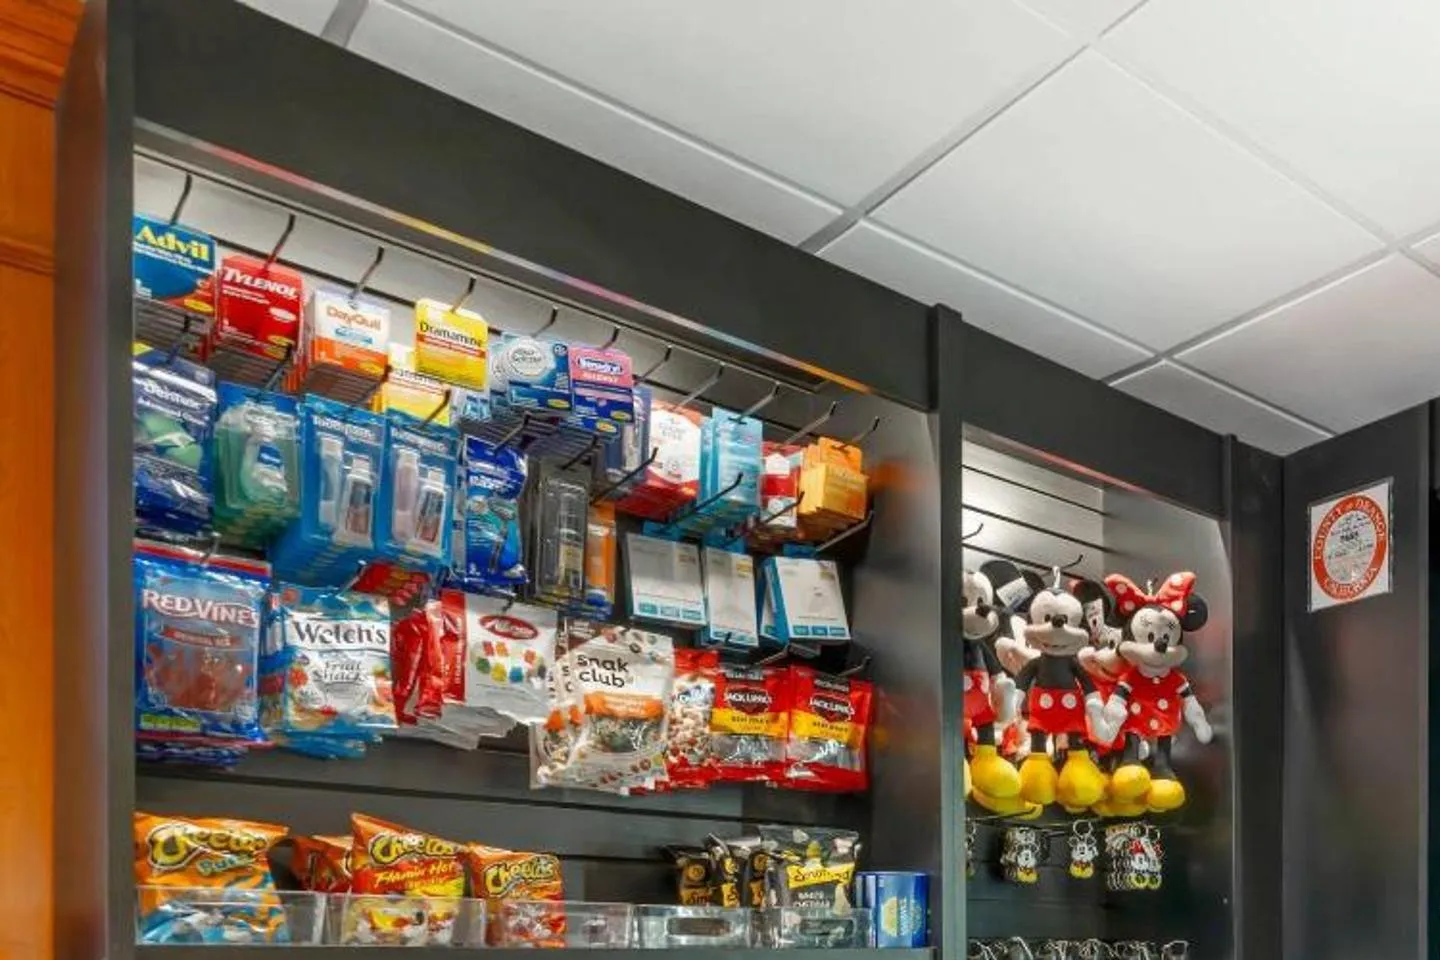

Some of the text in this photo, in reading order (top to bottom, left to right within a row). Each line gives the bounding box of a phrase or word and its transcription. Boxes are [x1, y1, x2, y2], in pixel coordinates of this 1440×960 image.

[136, 224, 209, 262] Advil
[223, 266, 300, 300] TYLENOL
[418, 320, 484, 348] Dramamine
[142, 588, 259, 628] RED VINES
[291, 620, 388, 645] Welch's
[576, 653, 630, 674] snak
[579, 668, 626, 688] club
[370, 833, 456, 866] Cheetos
[484, 860, 555, 895] Cheetos
